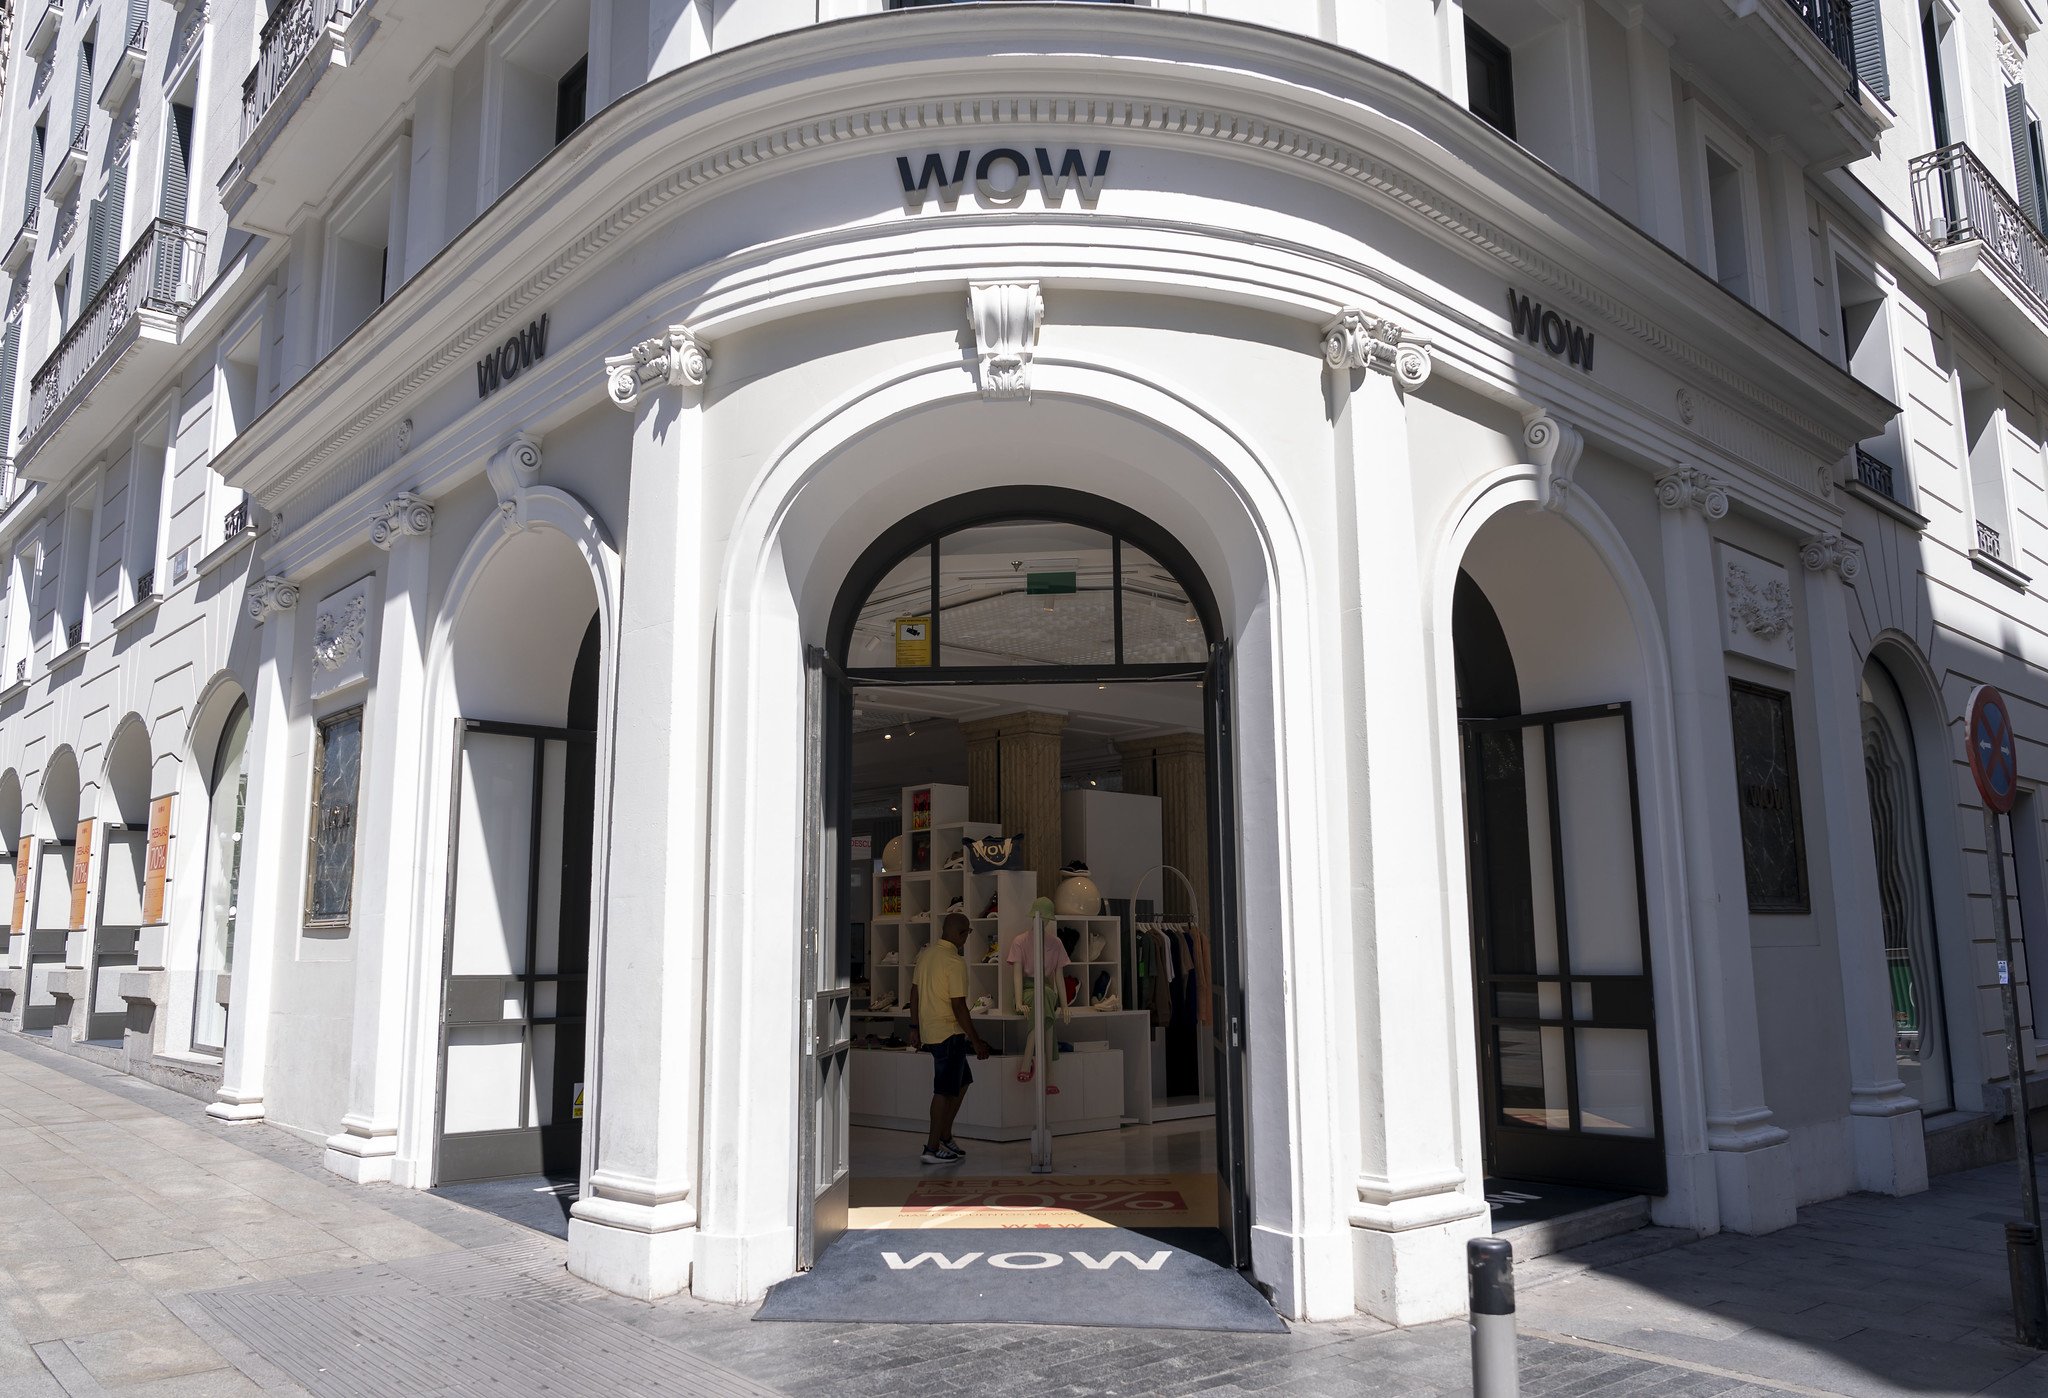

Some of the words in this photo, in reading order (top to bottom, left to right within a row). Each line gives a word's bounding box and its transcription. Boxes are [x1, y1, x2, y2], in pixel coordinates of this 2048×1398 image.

[896, 148, 1111, 207] WOW
[1509, 287, 1594, 371] WOW
[476, 312, 547, 398] WOW
[149, 846, 166, 870] 70%
[916, 1178, 1172, 1188] REBAJAS
[917, 1191, 1176, 1211] 70%
[881, 1251, 1173, 1270] WOW
